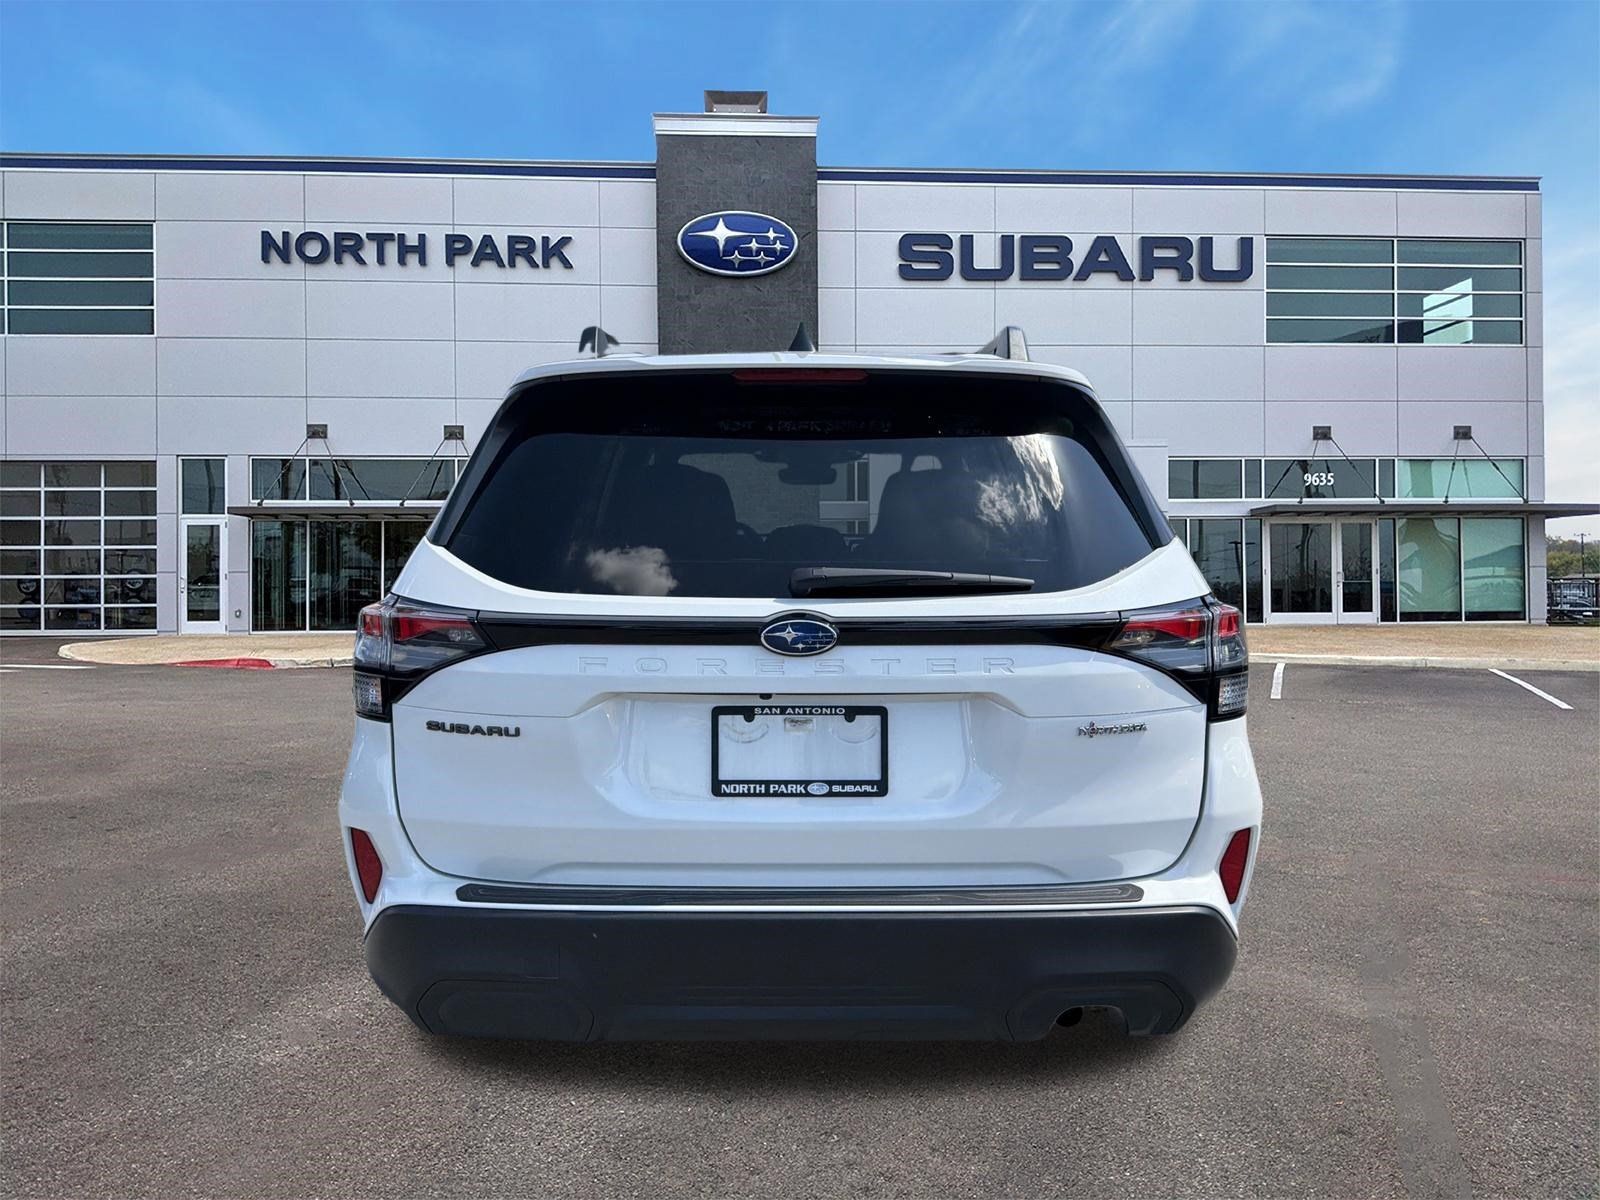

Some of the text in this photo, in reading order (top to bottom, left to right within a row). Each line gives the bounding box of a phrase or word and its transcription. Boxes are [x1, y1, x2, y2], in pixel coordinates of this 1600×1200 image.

[261, 230, 574, 269] NORTH PARK
[898, 233, 1254, 282] SUBARU
[1303, 472, 1335, 486] 9635
[577, 656, 1017, 676] FORESTER
[754, 707, 846, 715] SAN ANTONIO
[426, 720, 521, 738] SUBARU
[720, 783, 877, 794] NORTH PARK SUBARU
